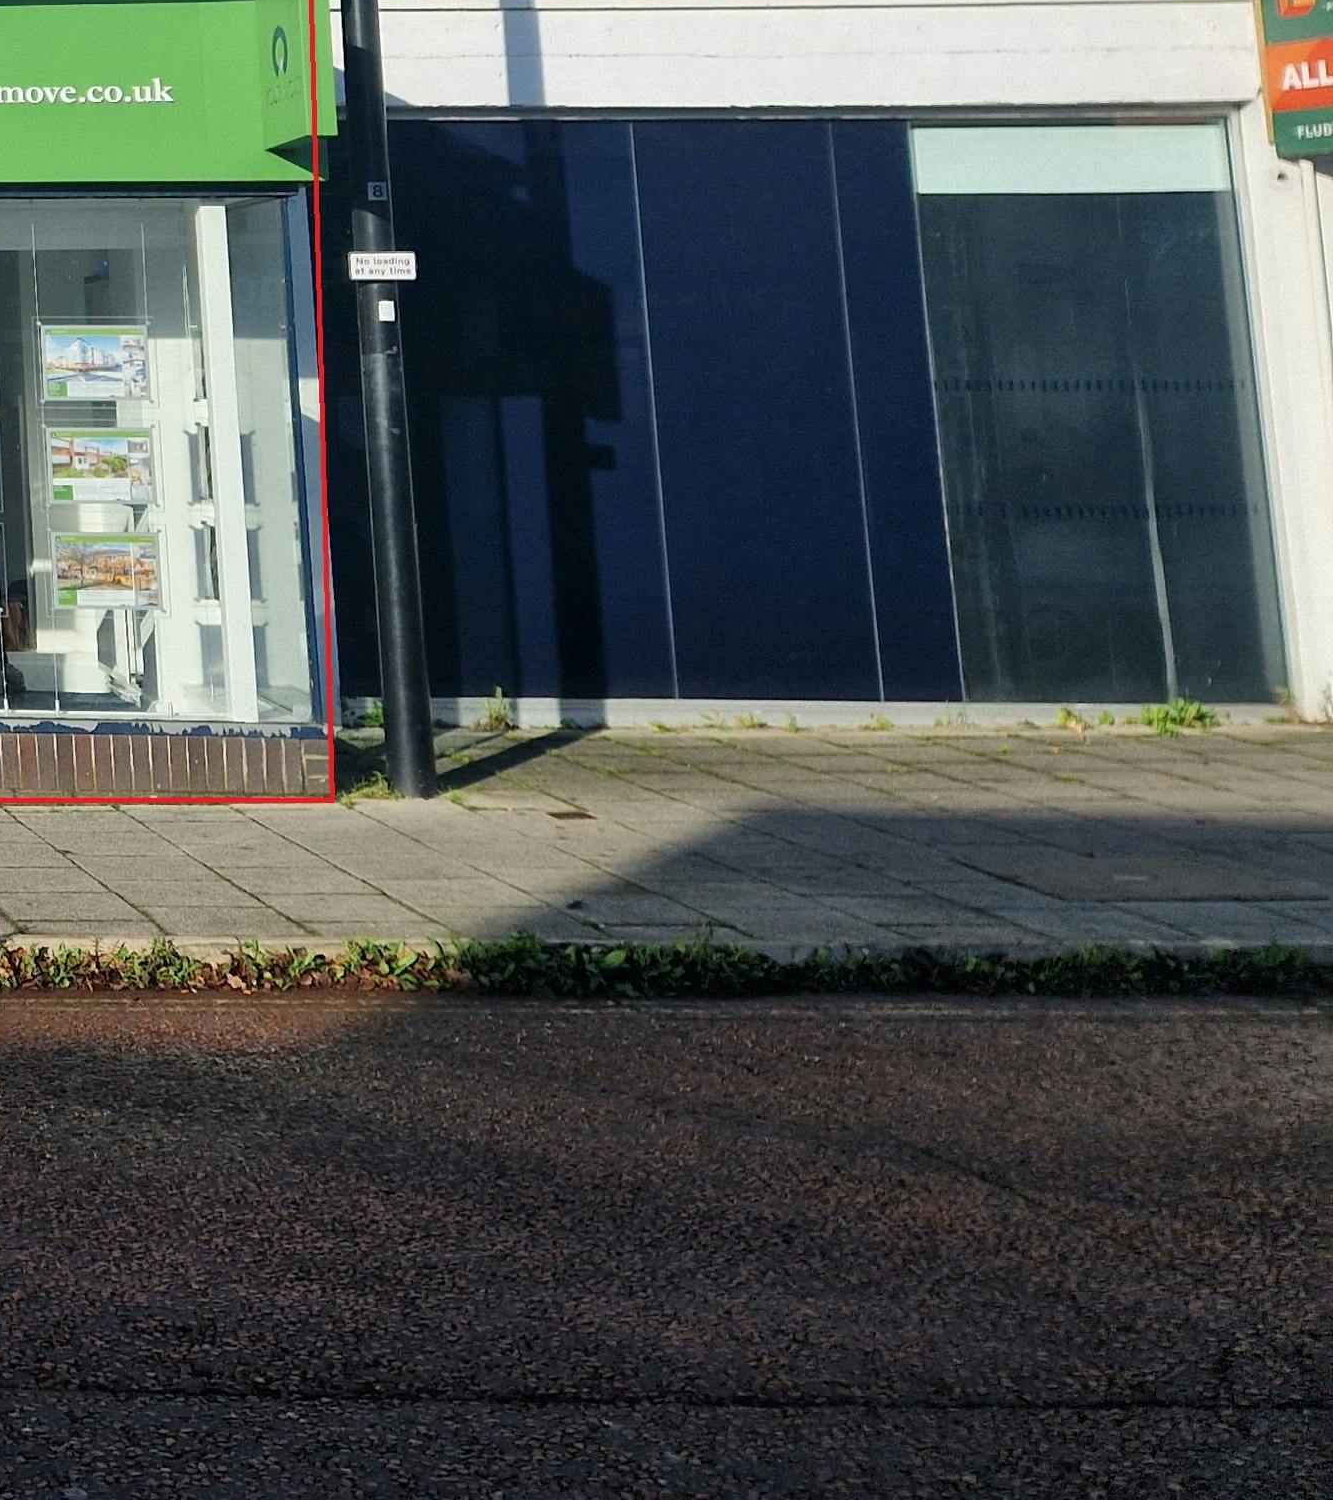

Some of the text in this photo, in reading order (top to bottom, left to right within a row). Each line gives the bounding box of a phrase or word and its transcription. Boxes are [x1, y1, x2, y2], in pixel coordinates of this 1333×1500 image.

[1282, 59, 1333, 91] ALL
[1296, 122, 1333, 141] FLUD
[372, 184, 383, 198] 8
[356, 256, 411, 267] No loading
[355, 267, 412, 276] at any time
